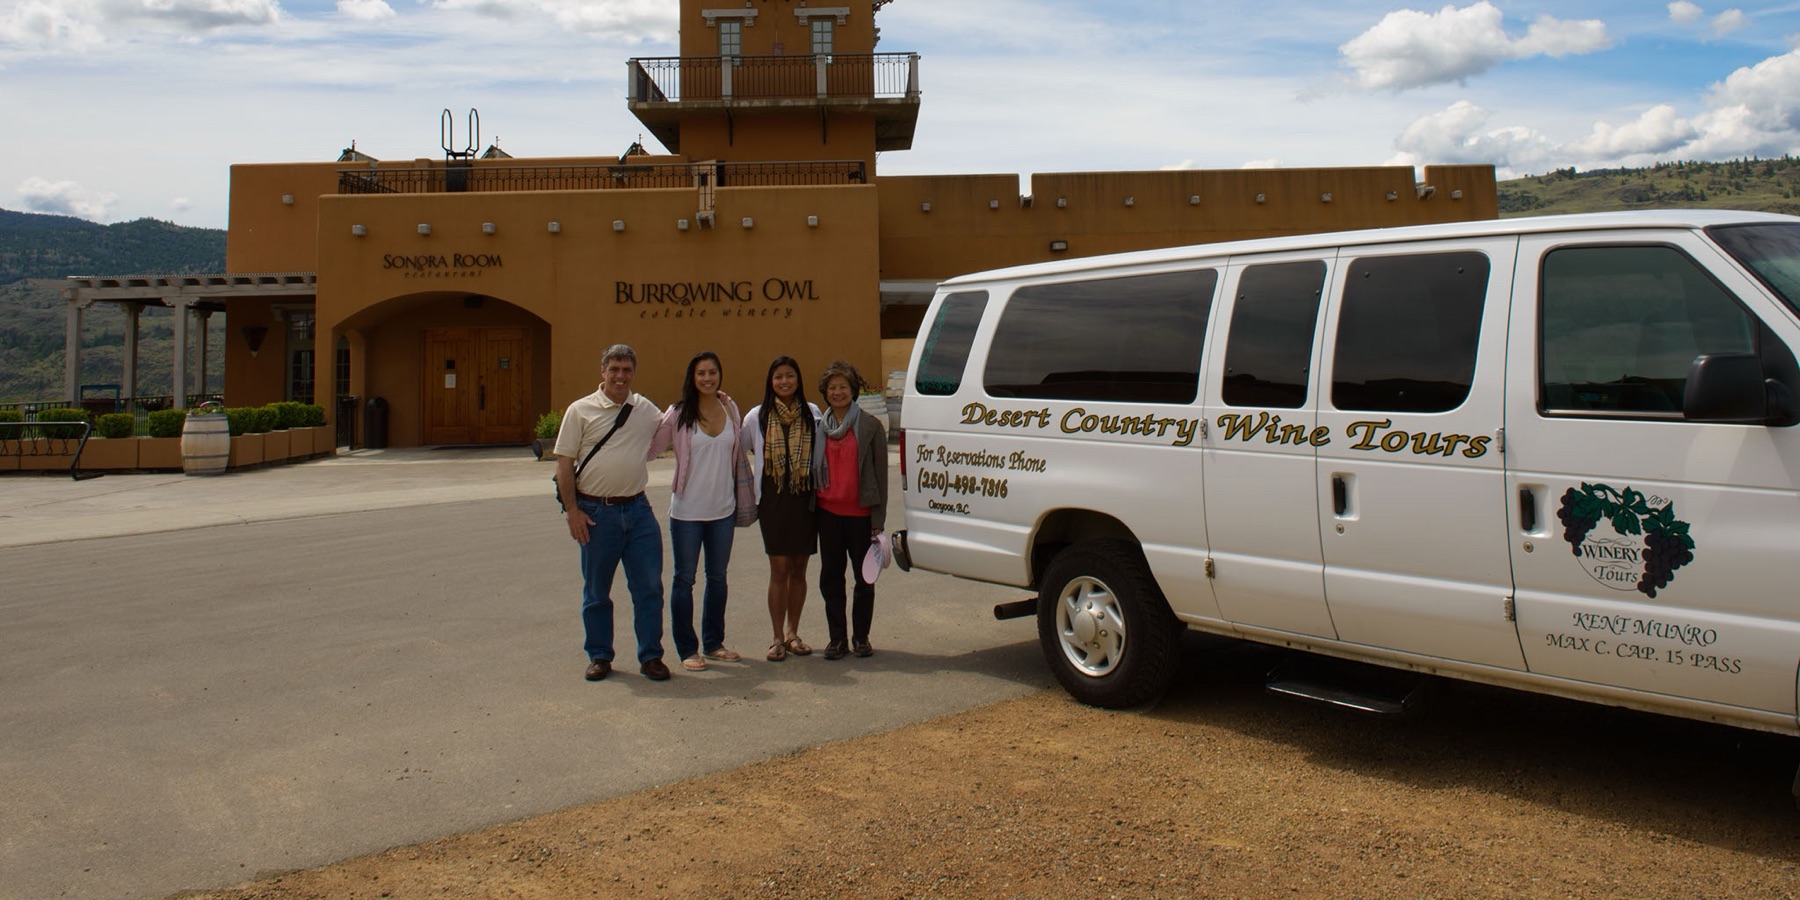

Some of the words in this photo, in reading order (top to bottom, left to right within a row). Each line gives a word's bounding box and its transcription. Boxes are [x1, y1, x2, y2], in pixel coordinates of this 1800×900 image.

[383, 254, 448, 271] SONORA
[453, 253, 503, 268] ROOM
[404, 270, 482, 278] restaurant
[615, 281, 752, 304] BURROWING
[762, 278, 820, 301] OWL
[640, 307, 707, 319] estate
[722, 305, 793, 319] winery
[960, 402, 1051, 428] Desert
[1060, 407, 1198, 446] Country
[1217, 411, 1331, 446] Wine
[1346, 418, 1492, 458] Tours
[916, 444, 934, 463] For
[937, 445, 1005, 469] Reservations
[1008, 449, 1046, 473] Phone
[1582, 544, 1641, 563] WINERY
[1594, 565, 1638, 583] Tours
[1573, 612, 1632, 636] KENT
[1633, 619, 1718, 647] MUNRO
[1546, 633, 1590, 652] MAX
[1594, 640, 1611, 655] C.
[1616, 643, 1659, 662] CAP.
[1666, 650, 1684, 666] 15
[1690, 653, 1743, 675] PASS
